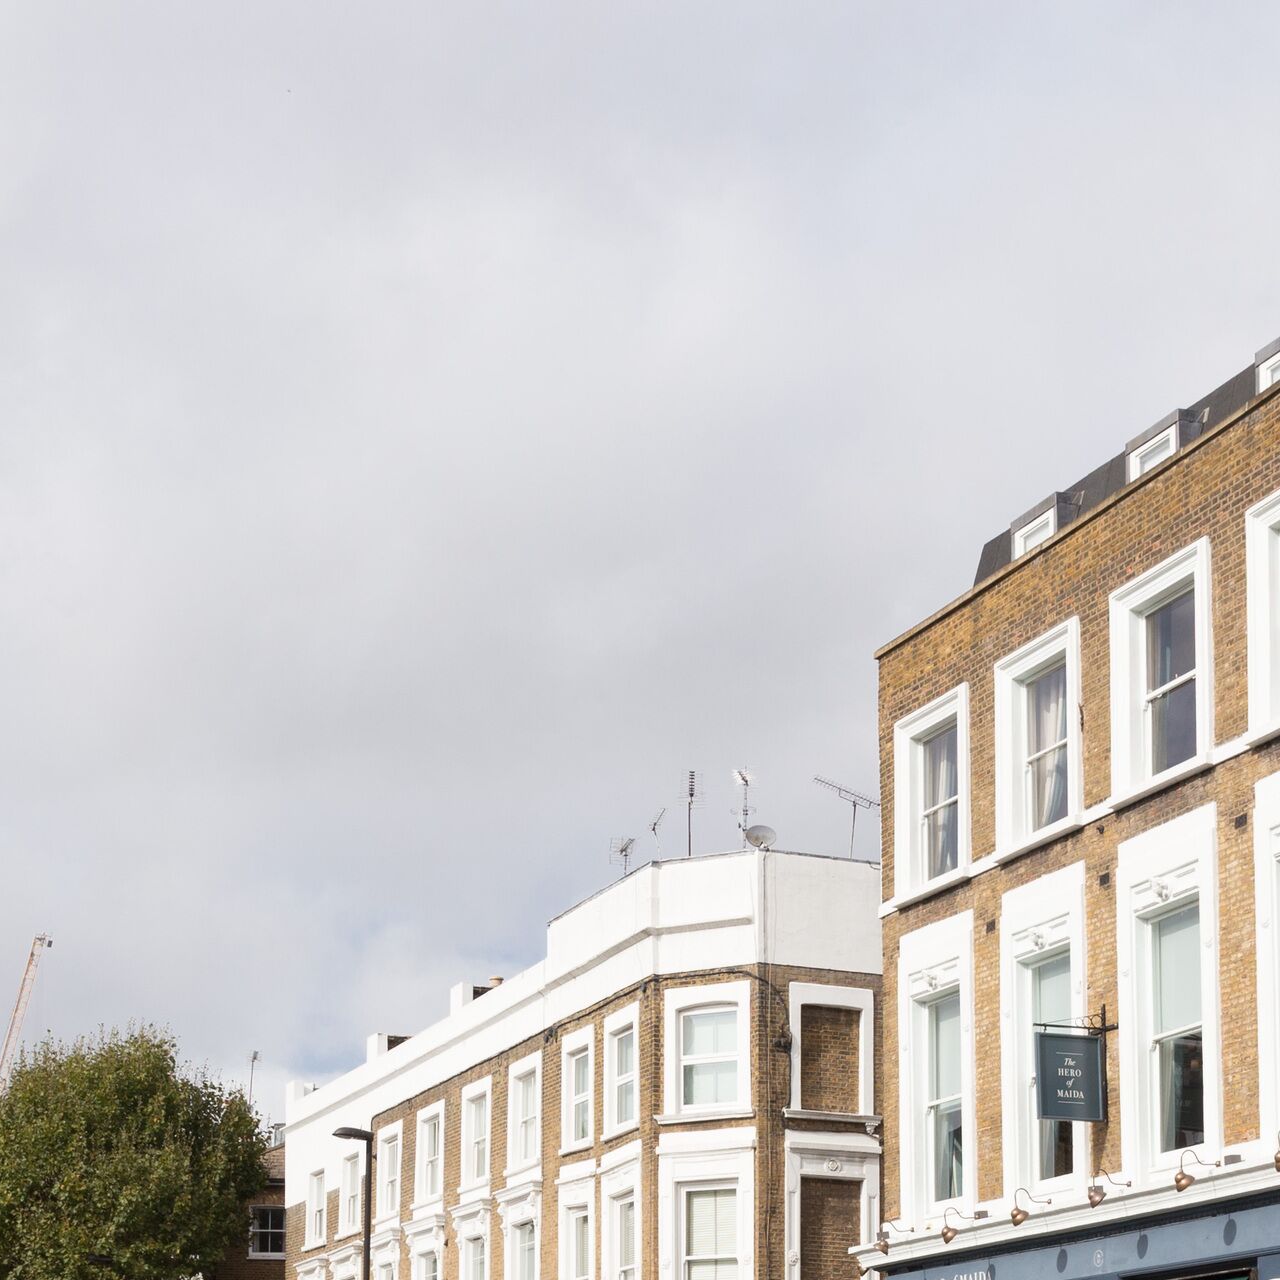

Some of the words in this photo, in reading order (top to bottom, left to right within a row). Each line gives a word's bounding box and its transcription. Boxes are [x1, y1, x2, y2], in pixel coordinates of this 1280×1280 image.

[1064, 1058, 1076, 1067] The
[1058, 1068, 1082, 1077] HERO
[1066, 1078, 1075, 1088] of
[1057, 1089, 1085, 1099] MAIDA
